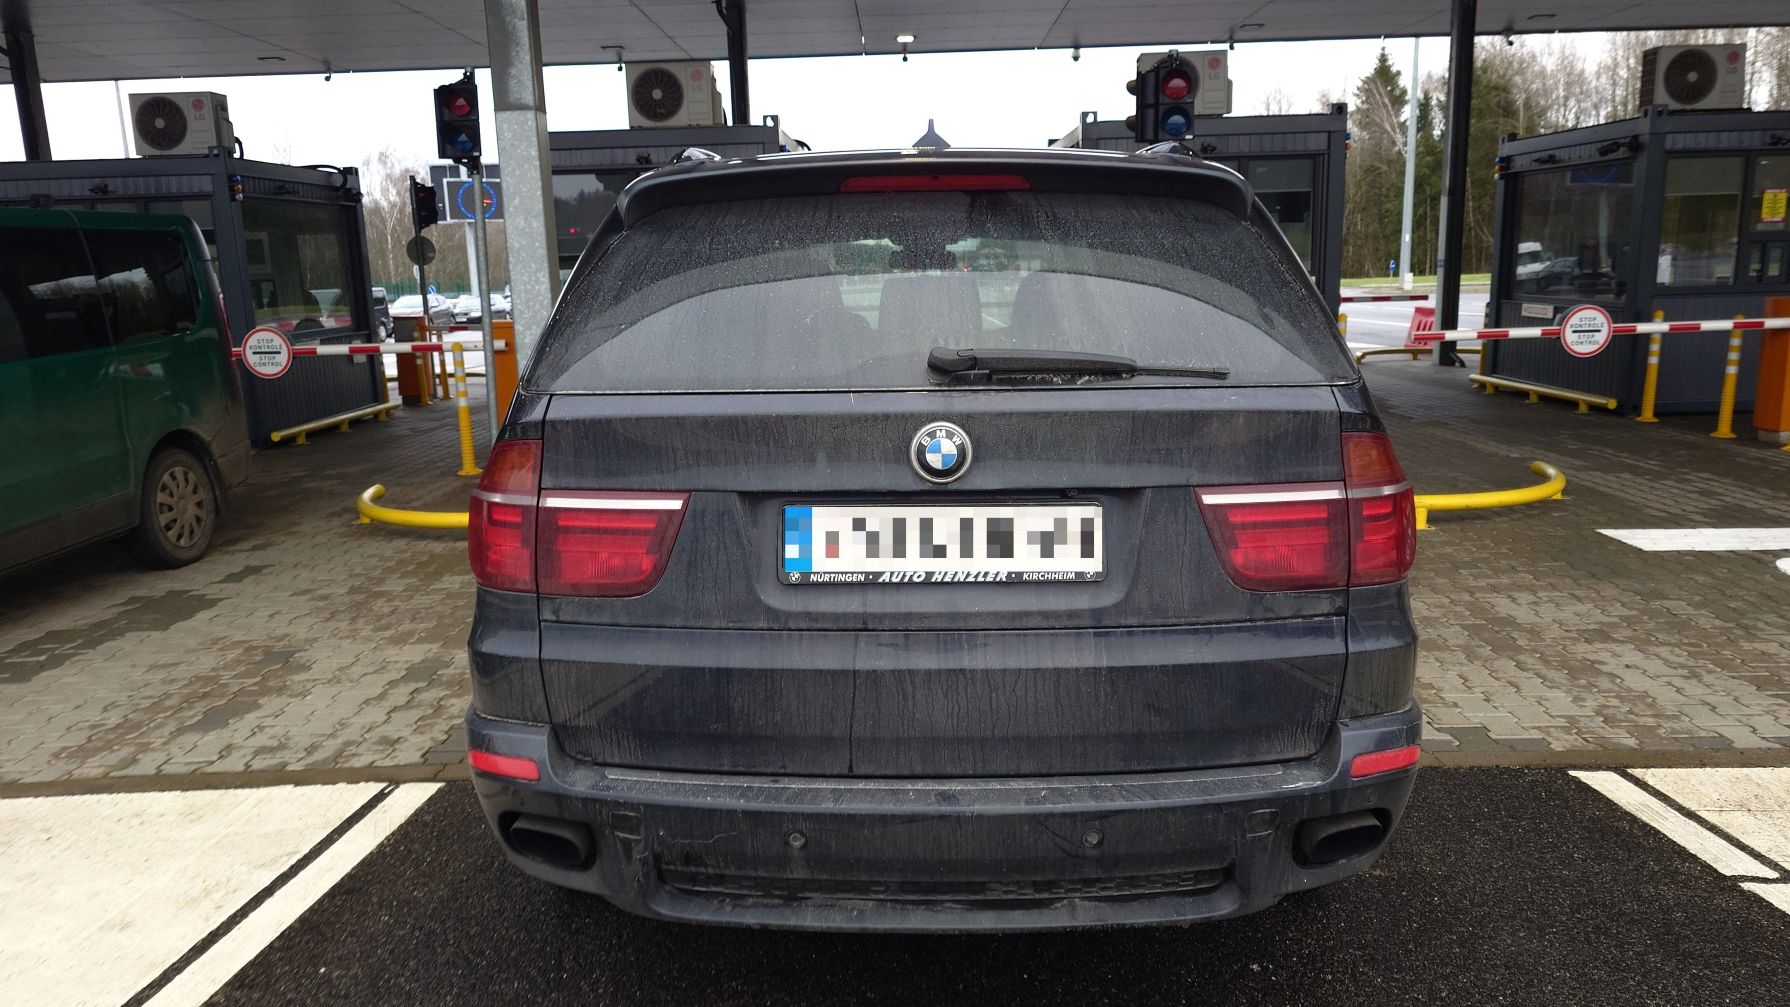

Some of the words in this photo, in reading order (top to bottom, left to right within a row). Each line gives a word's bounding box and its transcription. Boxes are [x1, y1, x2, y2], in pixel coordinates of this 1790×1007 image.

[194, 112, 206, 121] LG
[920, 429, 962, 446] BMW
[809, 571, 866, 582] NÜRTINGEN
[877, 571, 926, 583] AUTO
[930, 570, 1009, 582] HENZLER
[1022, 571, 1076, 581] KIRCHHEIM
